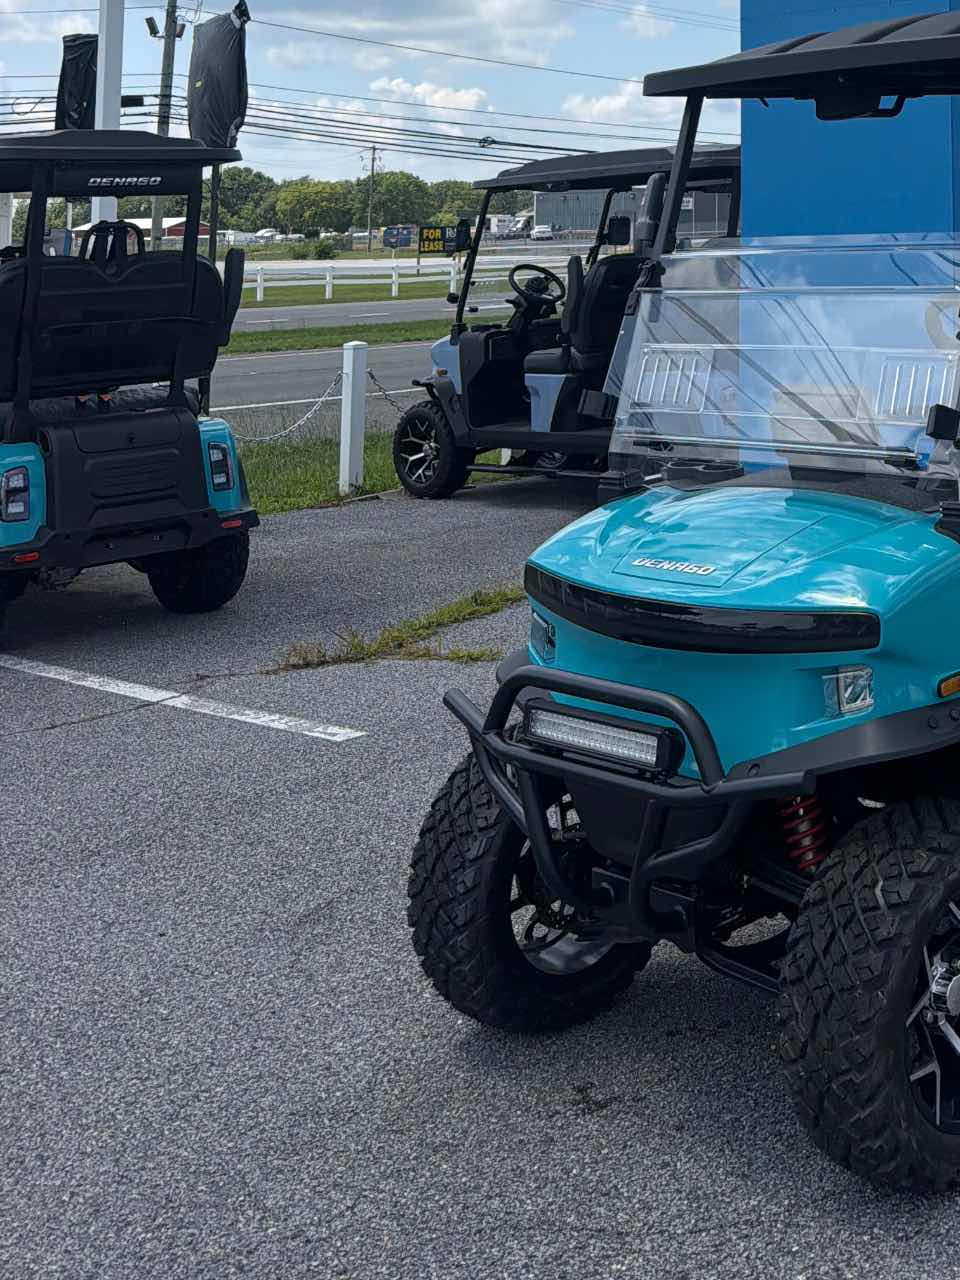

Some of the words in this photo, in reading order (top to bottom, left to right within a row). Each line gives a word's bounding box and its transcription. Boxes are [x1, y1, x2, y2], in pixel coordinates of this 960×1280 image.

[87, 176, 163, 187] DENAGO
[422, 228, 442, 240] FOR
[420, 241, 444, 252] LEASE
[631, 557, 717, 576] DENAGO
